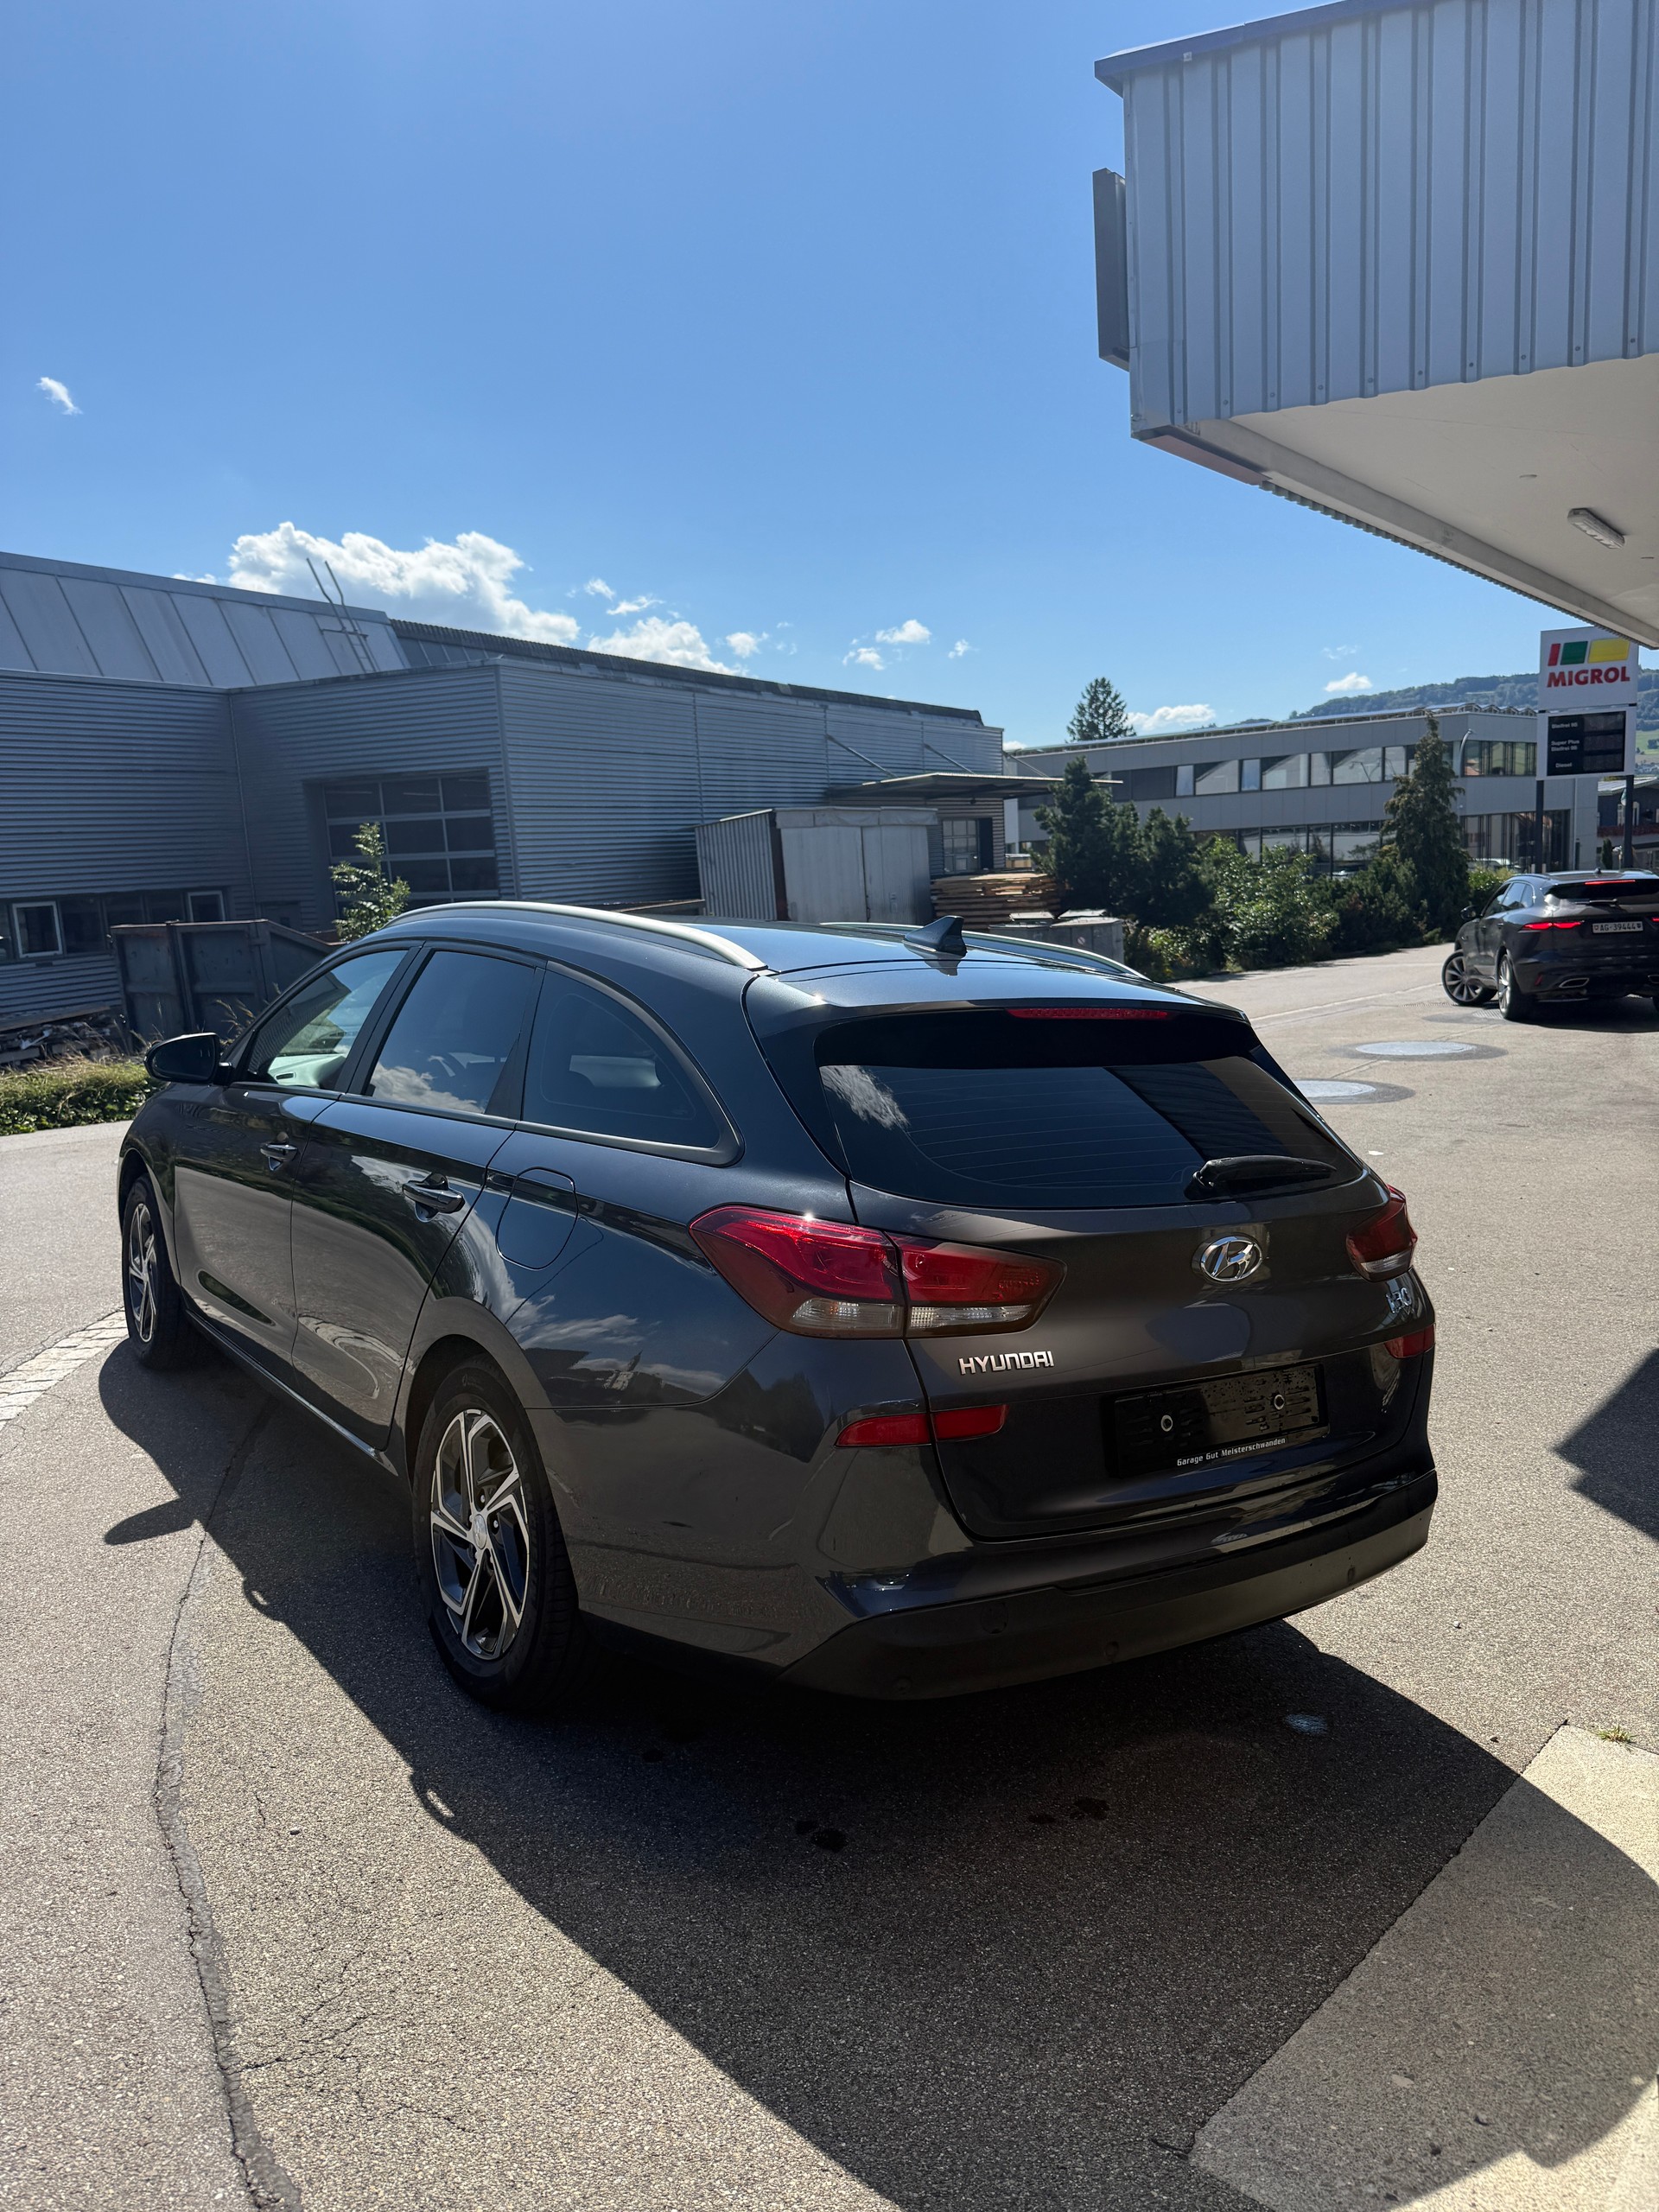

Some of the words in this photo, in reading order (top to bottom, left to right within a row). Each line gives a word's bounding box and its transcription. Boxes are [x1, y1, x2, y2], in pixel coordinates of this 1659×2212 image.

[1547, 666, 1630, 688] MIGROL
[958, 1351, 1055, 1375] HYUNDAI
[1177, 1455, 1204, 1466] Garage
[1205, 1452, 1219, 1460] Gut
[1221, 1438, 1286, 1457] Meisterschwanden
